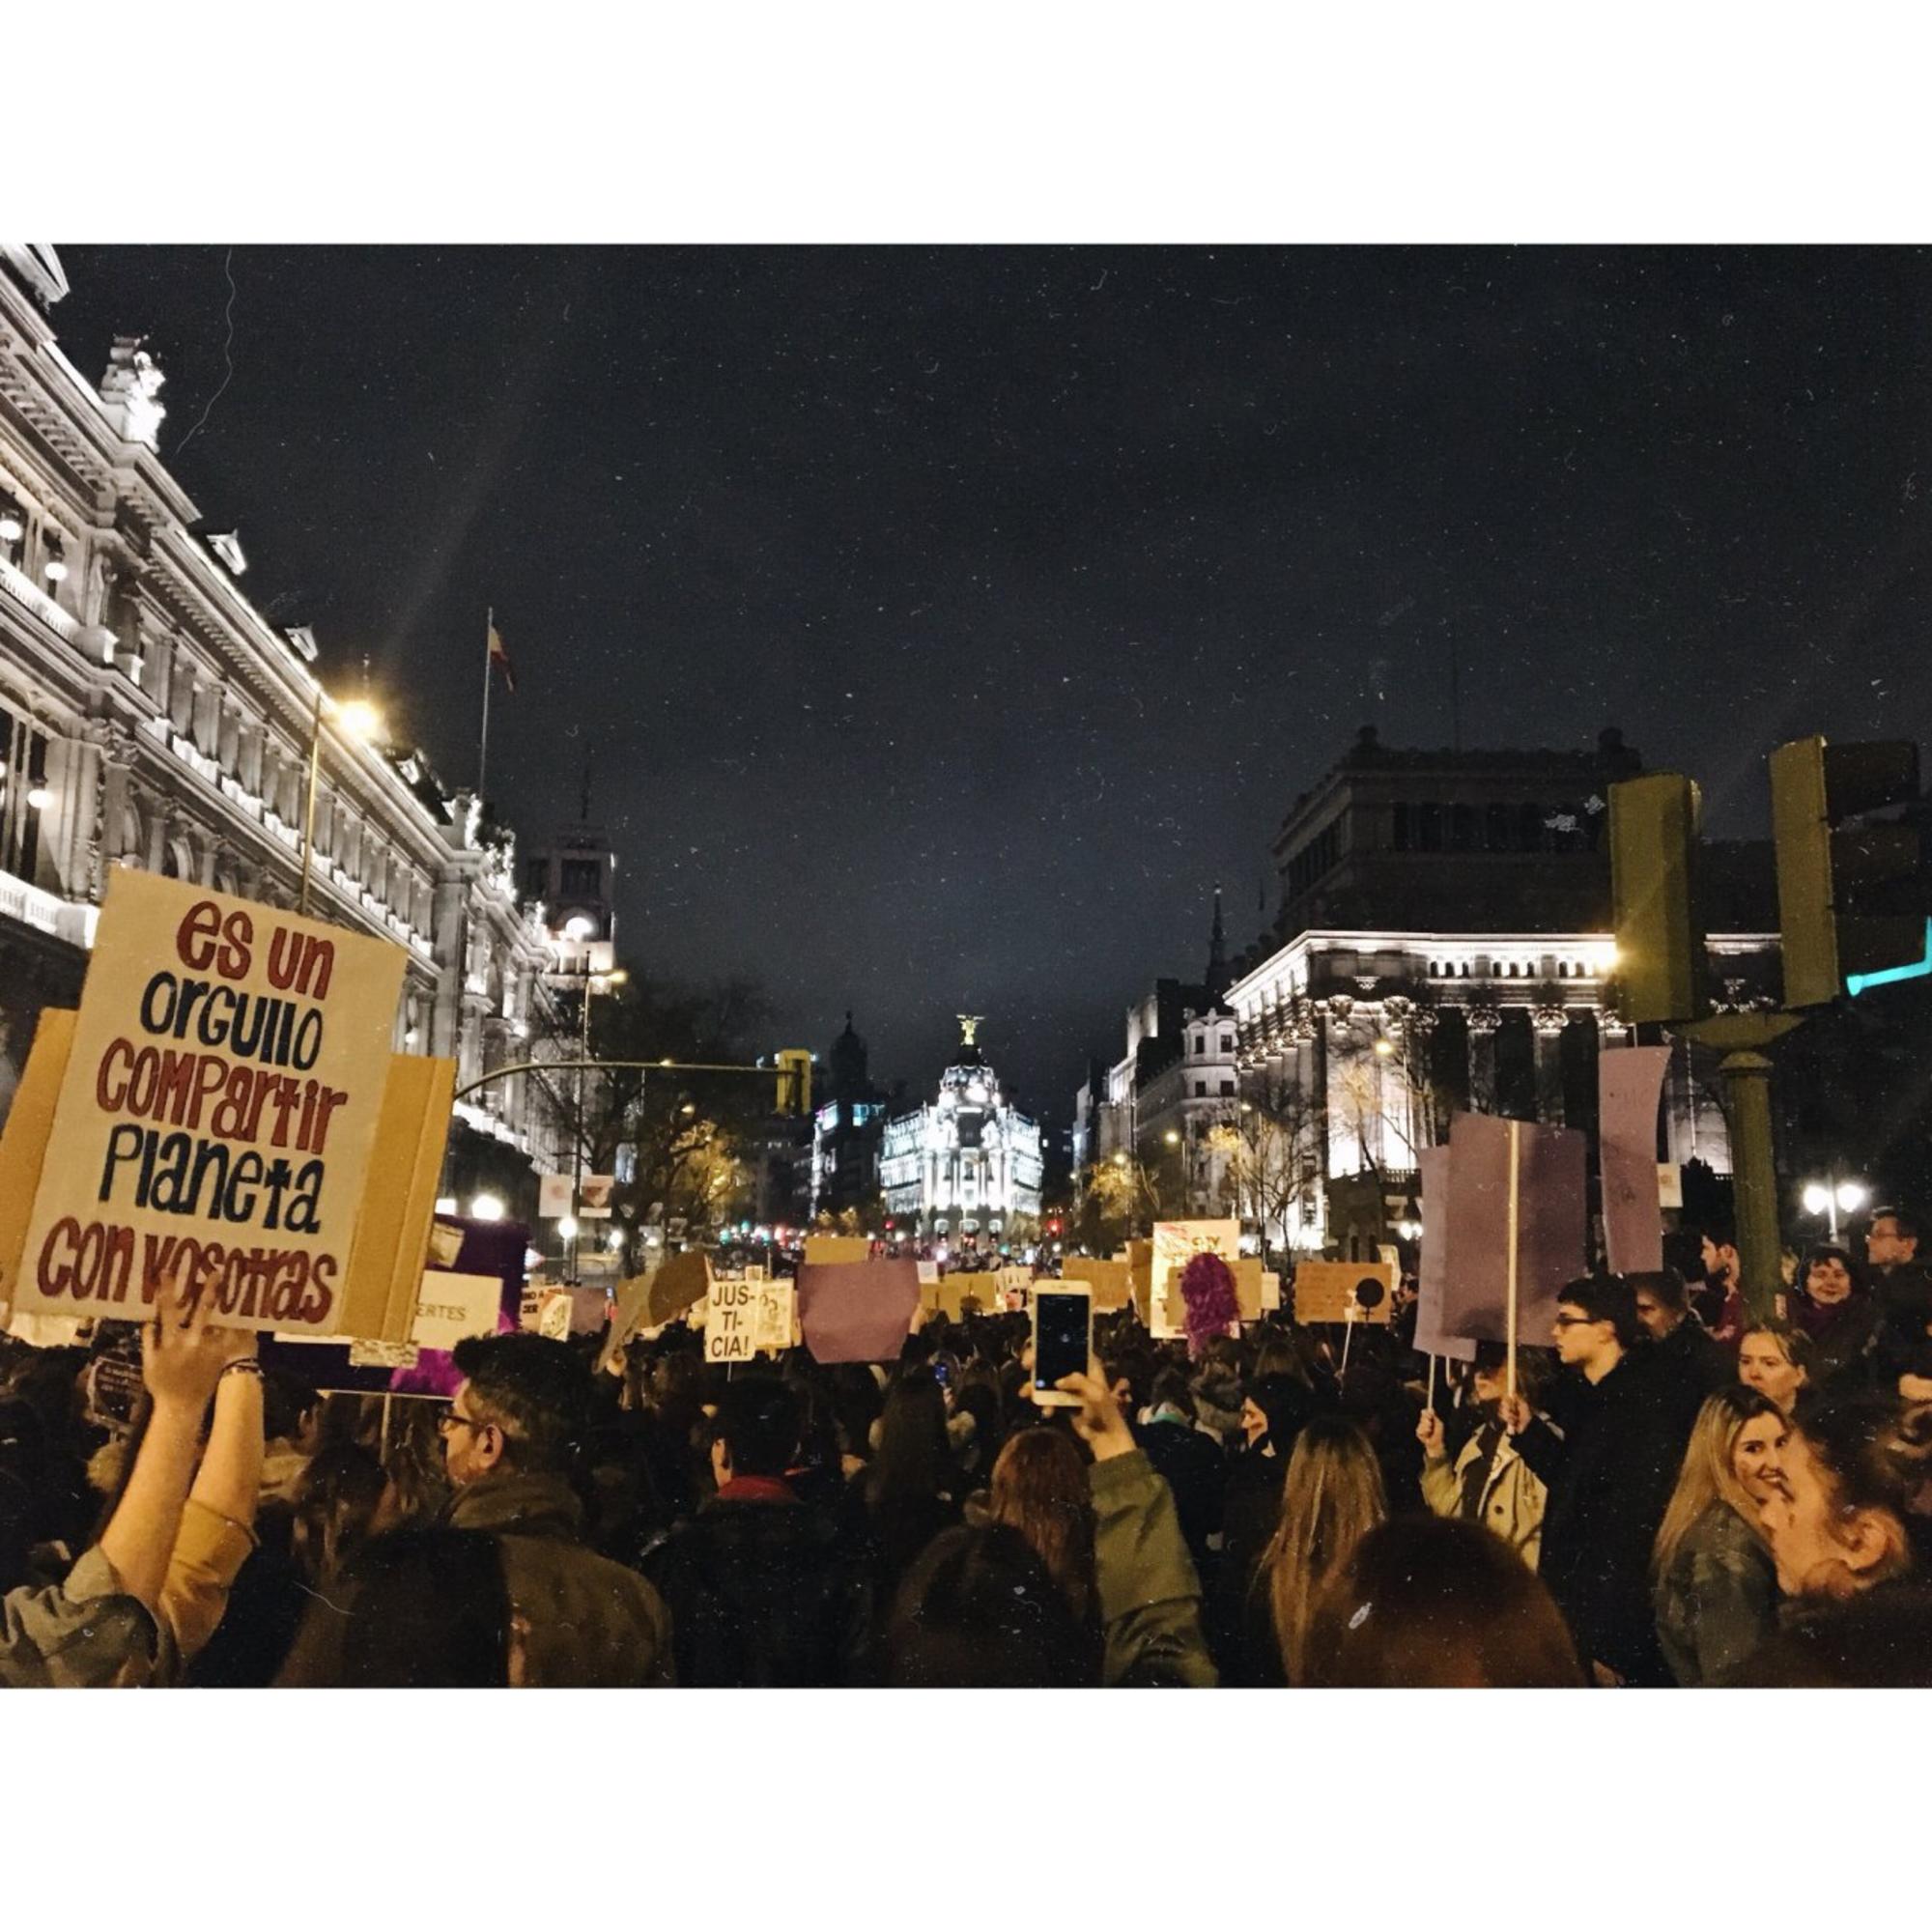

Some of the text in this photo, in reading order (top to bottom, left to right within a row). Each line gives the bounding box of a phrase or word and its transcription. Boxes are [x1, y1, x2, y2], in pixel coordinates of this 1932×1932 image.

[177, 900, 334, 1001] es un
[37, 1216, 135, 1303] con
[711, 1335, 749, 1357] CIA!
